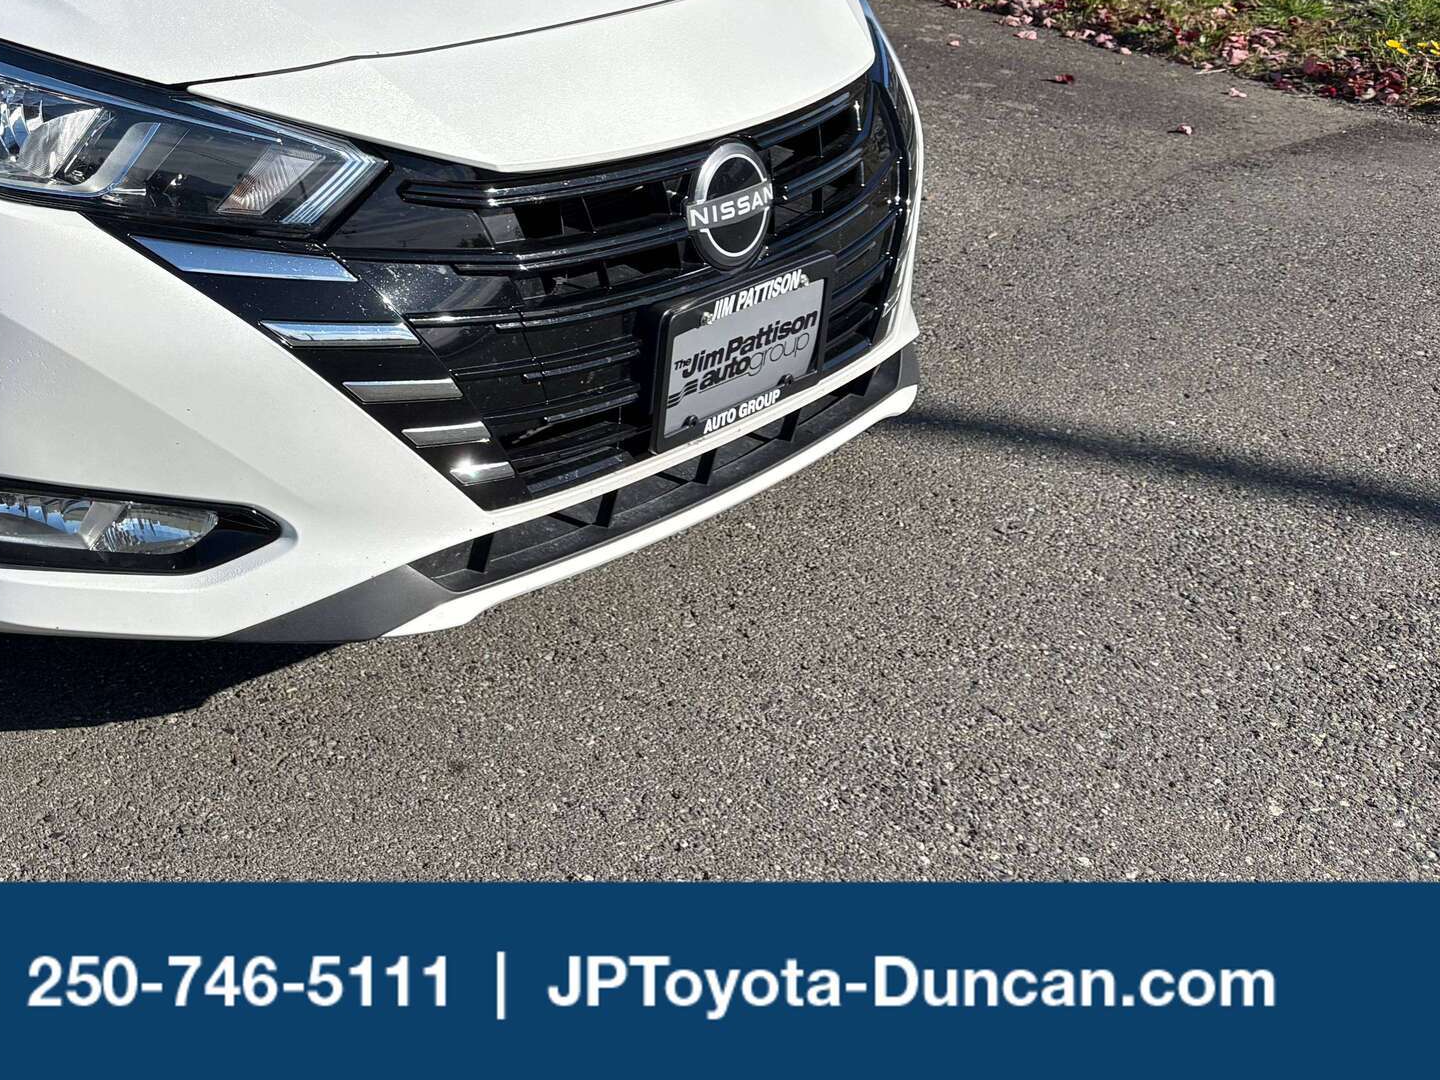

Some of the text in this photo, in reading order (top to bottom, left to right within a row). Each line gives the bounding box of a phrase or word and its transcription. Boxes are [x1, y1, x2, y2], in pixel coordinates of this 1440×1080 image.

[689, 185, 774, 228] NISSAN
[711, 268, 803, 322] JIM PATTISON
[703, 388, 782, 435] AUTO GROUP
